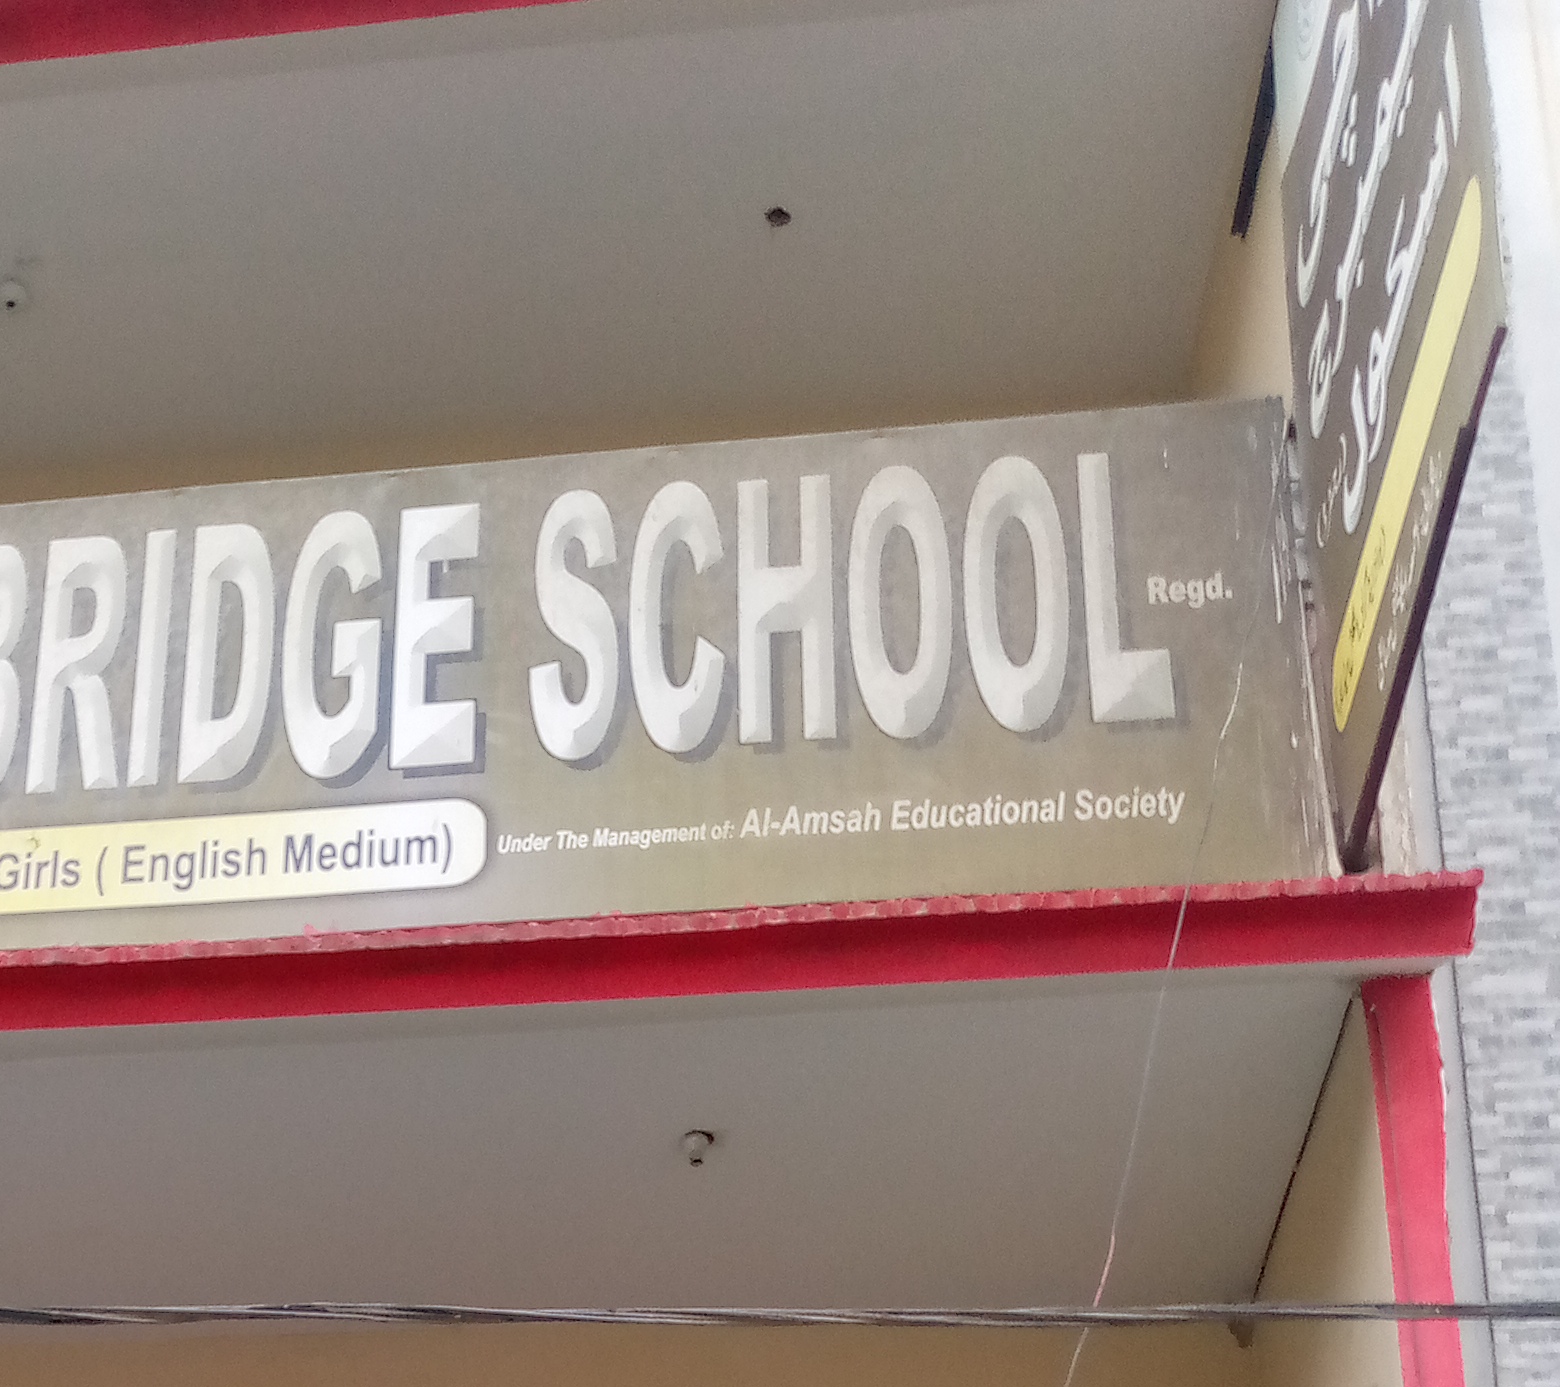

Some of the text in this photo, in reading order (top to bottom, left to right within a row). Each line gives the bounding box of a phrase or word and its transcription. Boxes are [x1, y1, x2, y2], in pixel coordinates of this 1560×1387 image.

[529, 452, 1176, 762] SCHOOL
[1146, 572, 1233, 609] Regd.
[497, 832, 552, 855] Under
[557, 830, 589, 851] The
[593, 821, 707, 852] Management
[740, 804, 881, 840] Al-Amsah
[890, 791, 1066, 833] Educational
[1074, 787, 1186, 825] Society
[121, 836, 268, 893] English
[282, 823, 454, 875] Medium)
